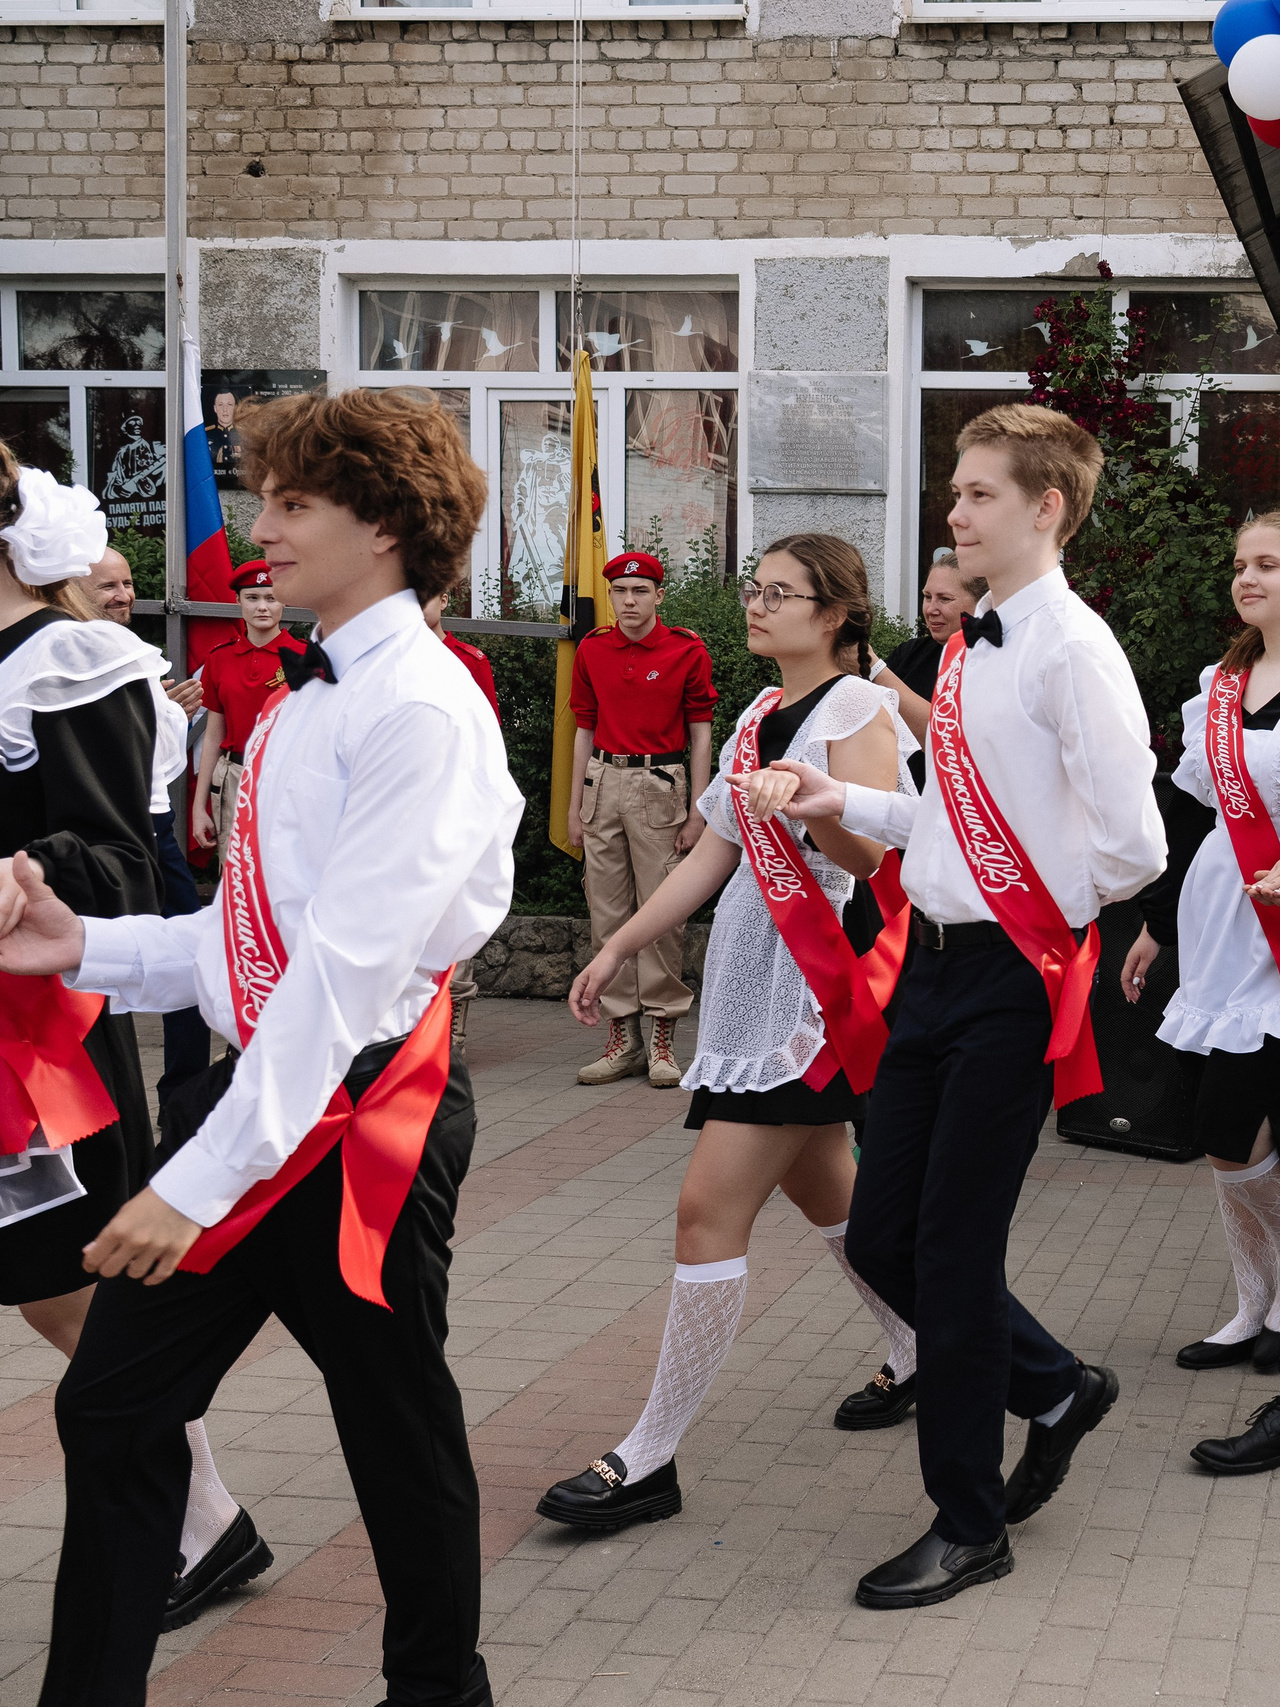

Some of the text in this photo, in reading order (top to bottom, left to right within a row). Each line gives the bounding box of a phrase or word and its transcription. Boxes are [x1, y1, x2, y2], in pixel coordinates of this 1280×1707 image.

[108, 502, 147, 514] ПАМЯТИ
[732, 726, 807, 902] Выускница 2025
[930, 693, 1030, 893] Выпускник 2025
[1210, 674, 1255, 819] Выпускница 2025
